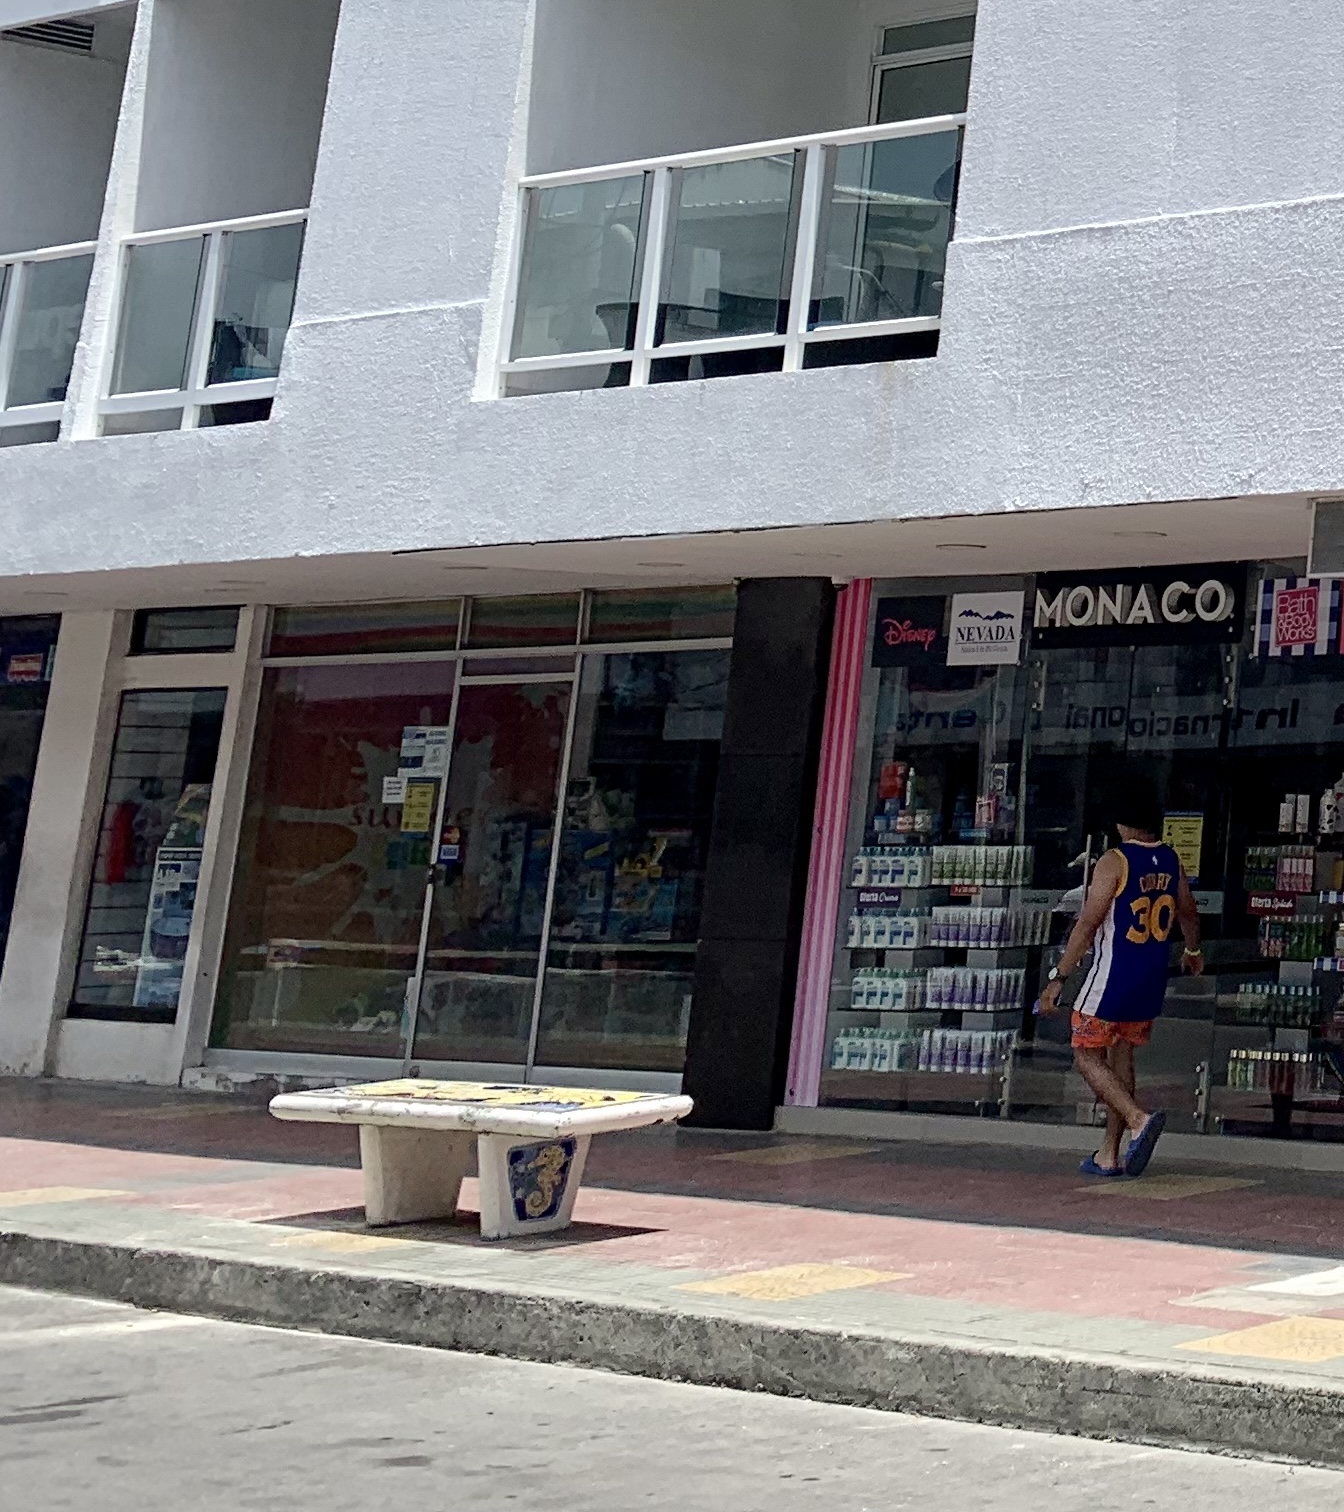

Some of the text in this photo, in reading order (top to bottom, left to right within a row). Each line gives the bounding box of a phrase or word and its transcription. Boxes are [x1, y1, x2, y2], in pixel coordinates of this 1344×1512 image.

[1277, 593, 1316, 616] Bath
[955, 625, 1017, 643] NEVADA
[1277, 625, 1316, 642] Works
[1126, 894, 1176, 944] 30
